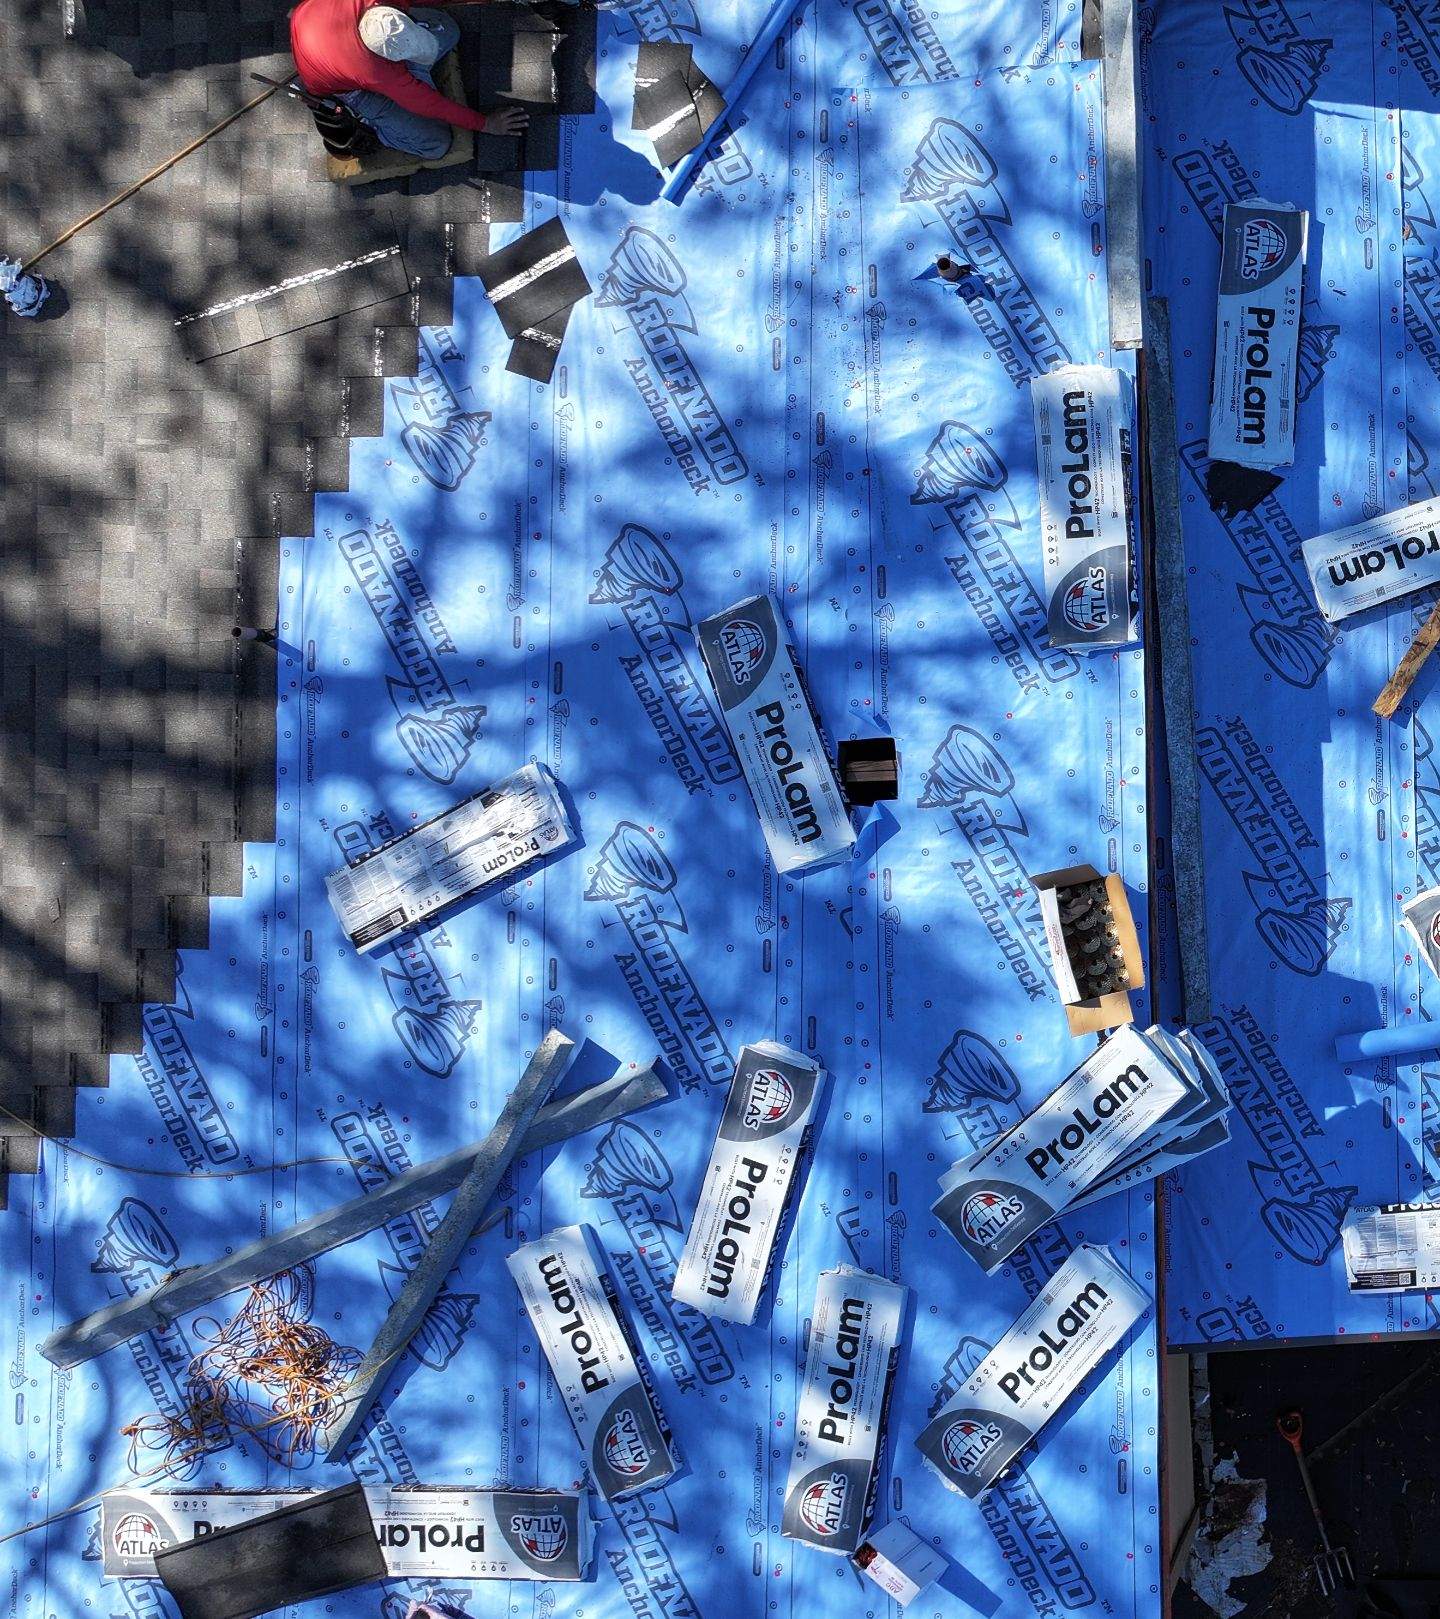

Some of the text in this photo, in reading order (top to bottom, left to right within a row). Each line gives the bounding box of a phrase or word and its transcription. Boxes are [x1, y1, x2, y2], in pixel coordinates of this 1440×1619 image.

[1245, 224, 1260, 280] ATLAS
[623, 357, 711, 496] AnchorDeck
[626, 298, 748, 485] ROOFNADO
[1242, 306, 1276, 446] ProLam
[1061, 389, 1094, 540] ProLam
[338, 528, 456, 712] ROOFNADO
[375, 519, 456, 656] AnchorDeck
[721, 630, 749, 685] ATLAS
[944, 555, 1041, 696] AnchorDeck
[1090, 566, 1108, 625] ATLAS
[619, 655, 705, 796] AnchorDeck
[621, 599, 744, 784] ROOFNADO
[755, 700, 824, 845] ProLam
[1196, 727, 1318, 907] ROOFNADO
[1224, 714, 1319, 850] AnchorDeck
[483, 836, 541, 875] ProLam
[614, 899, 737, 1085] ROOFNADO
[950, 858, 1046, 1001] AnchorDeck
[144, 1004, 239, 1166] OOFNADO
[614, 953, 701, 1096] AnchorDeck
[1230, 1003, 1325, 1140] AnchorDeck
[135, 1053, 205, 1174] nchorDeck
[744, 1071, 770, 1132] ATLAS
[1024, 1063, 1150, 1181] ProLam
[1206, 1015, 1324, 1197] ROOFNADO
[706, 1156, 767, 1299] ProLam
[978, 1196, 1024, 1243] ATLAS
[539, 1254, 609, 1395] ProLam
[611, 1250, 693, 1395] AnchorDeck
[613, 1197, 735, 1385] ROOFADO
[998, 1281, 1108, 1403] ProLam
[616, 1409, 650, 1464] ATLAS
[818, 1298, 866, 1445] ProLam
[824, 1472, 848, 1532] ATLAS
[959, 1423, 1001, 1472] ATLAS
[511, 1516, 562, 1532] ATLAS
